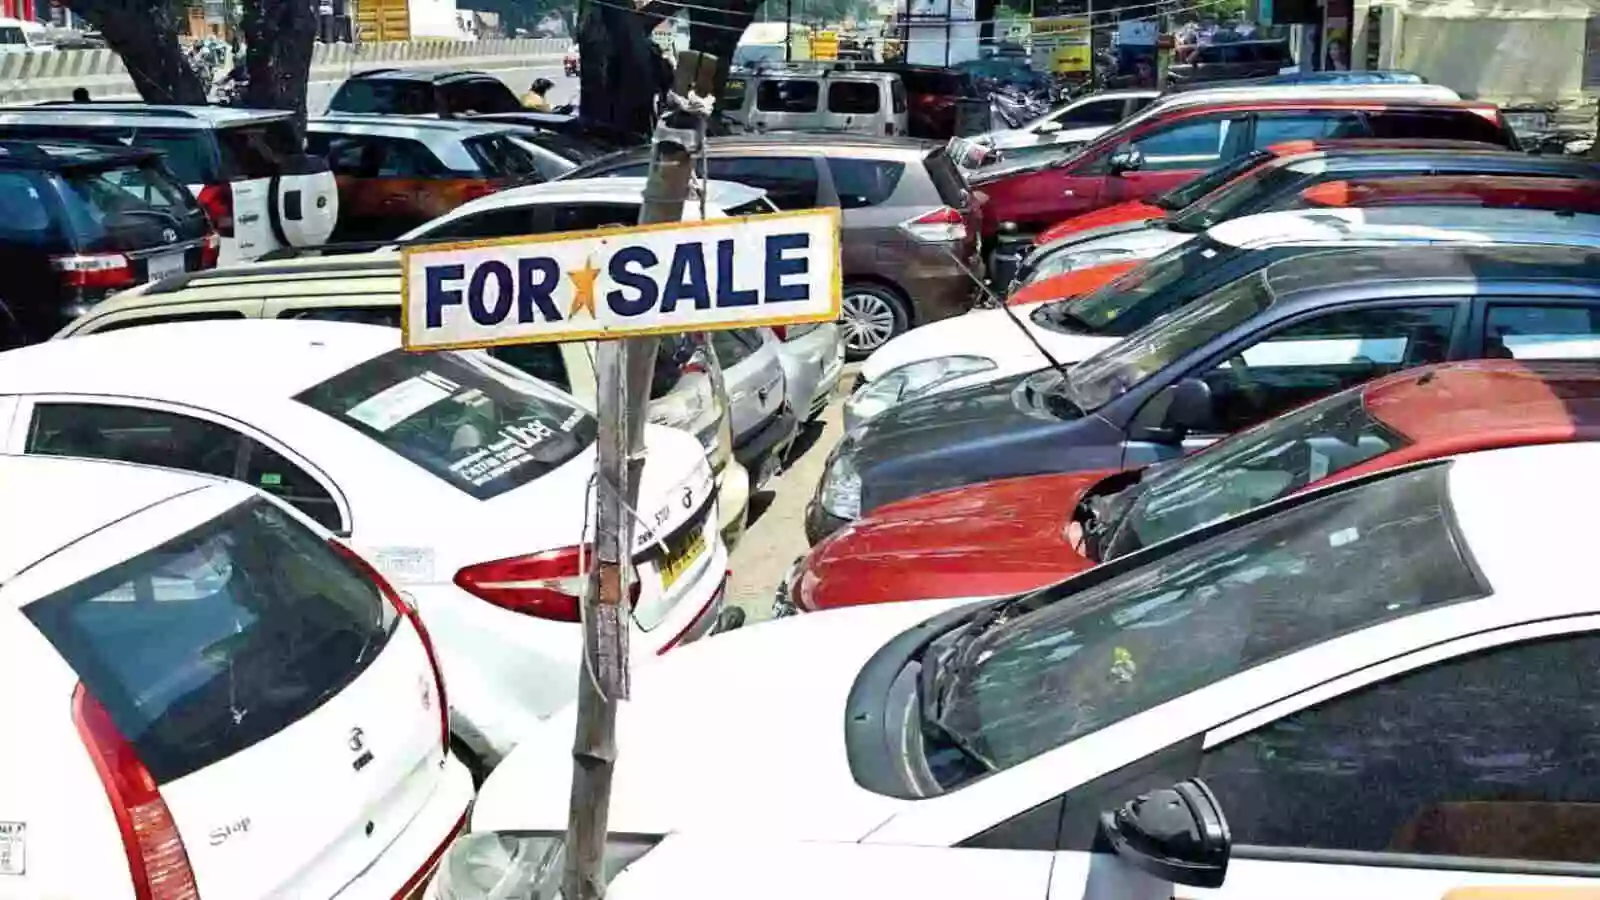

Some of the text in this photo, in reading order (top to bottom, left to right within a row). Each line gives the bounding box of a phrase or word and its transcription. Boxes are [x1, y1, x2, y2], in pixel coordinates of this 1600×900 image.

[425, 234, 810, 328] FOR SALE
[498, 419, 554, 449] Uber
[208, 815, 252, 846] Stop
